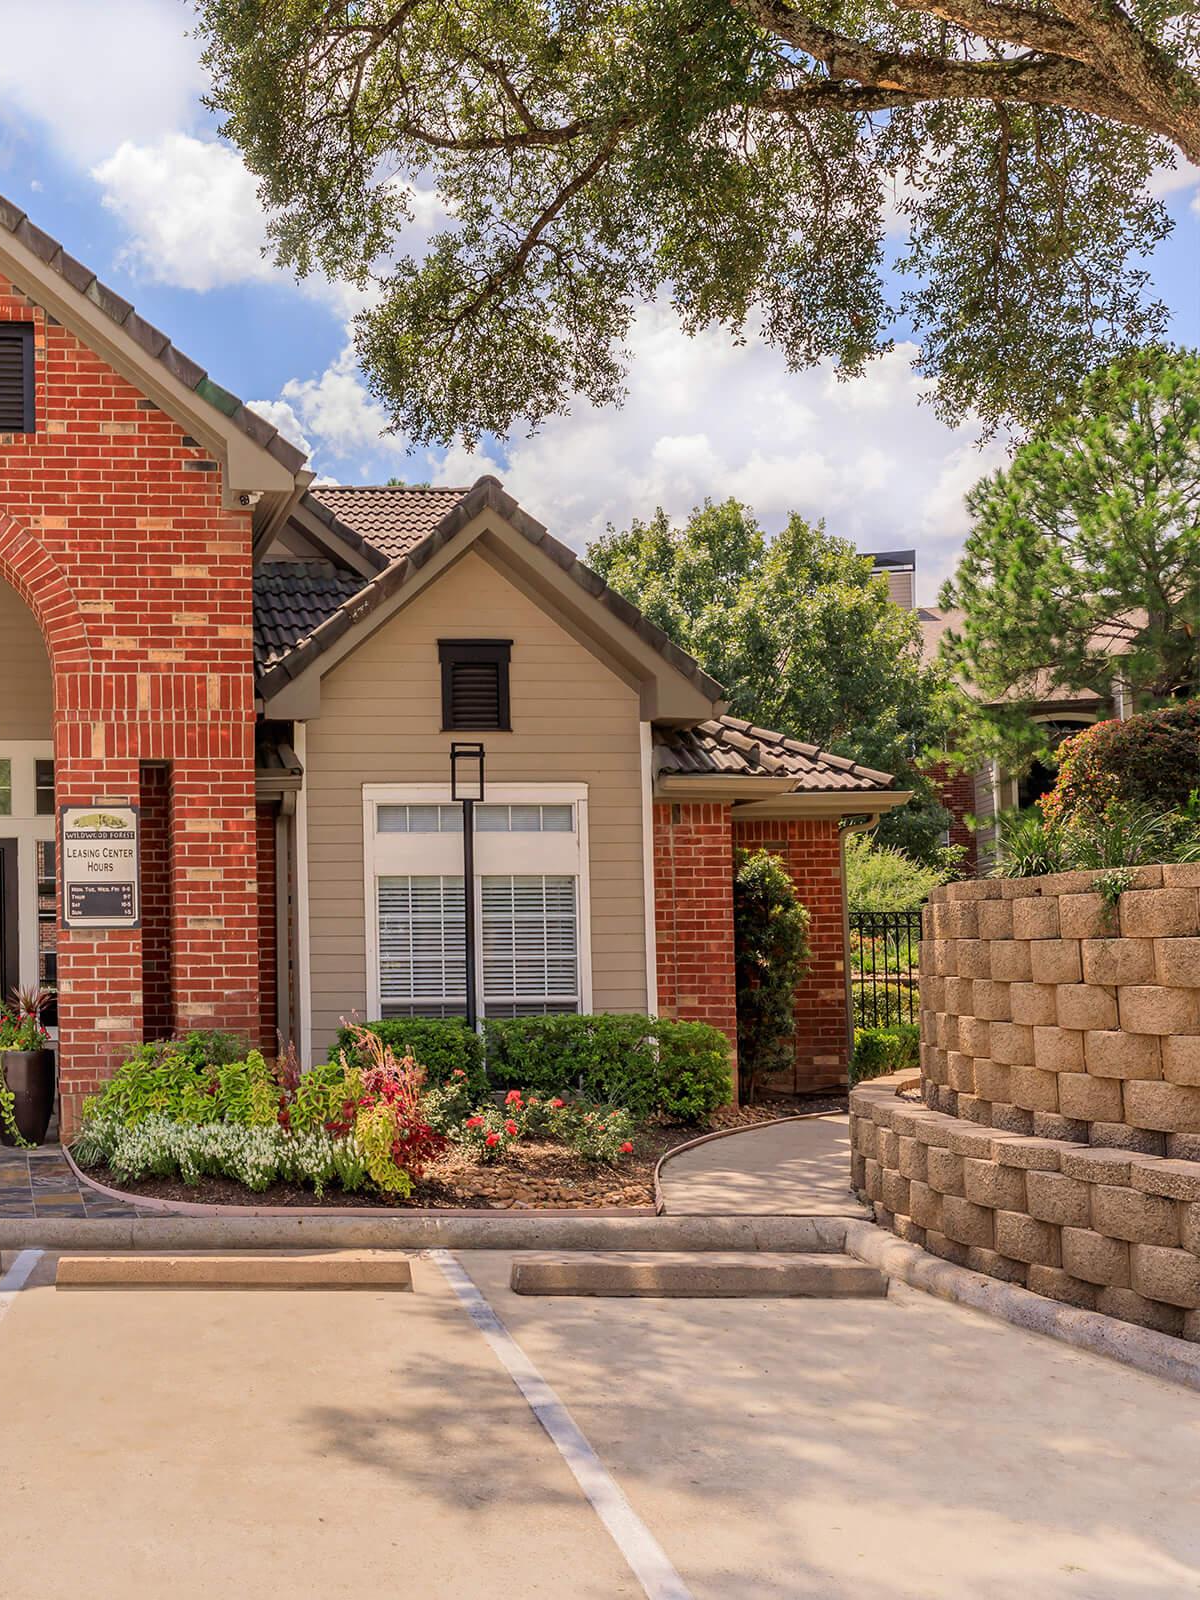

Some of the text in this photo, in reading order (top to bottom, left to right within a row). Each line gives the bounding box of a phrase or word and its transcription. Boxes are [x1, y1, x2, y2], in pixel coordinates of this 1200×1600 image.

[66, 831, 134, 839] WILDWOOD FOREST
[67, 848, 134, 858] LEASING CENTER
[87, 861, 114, 872] HOURS
